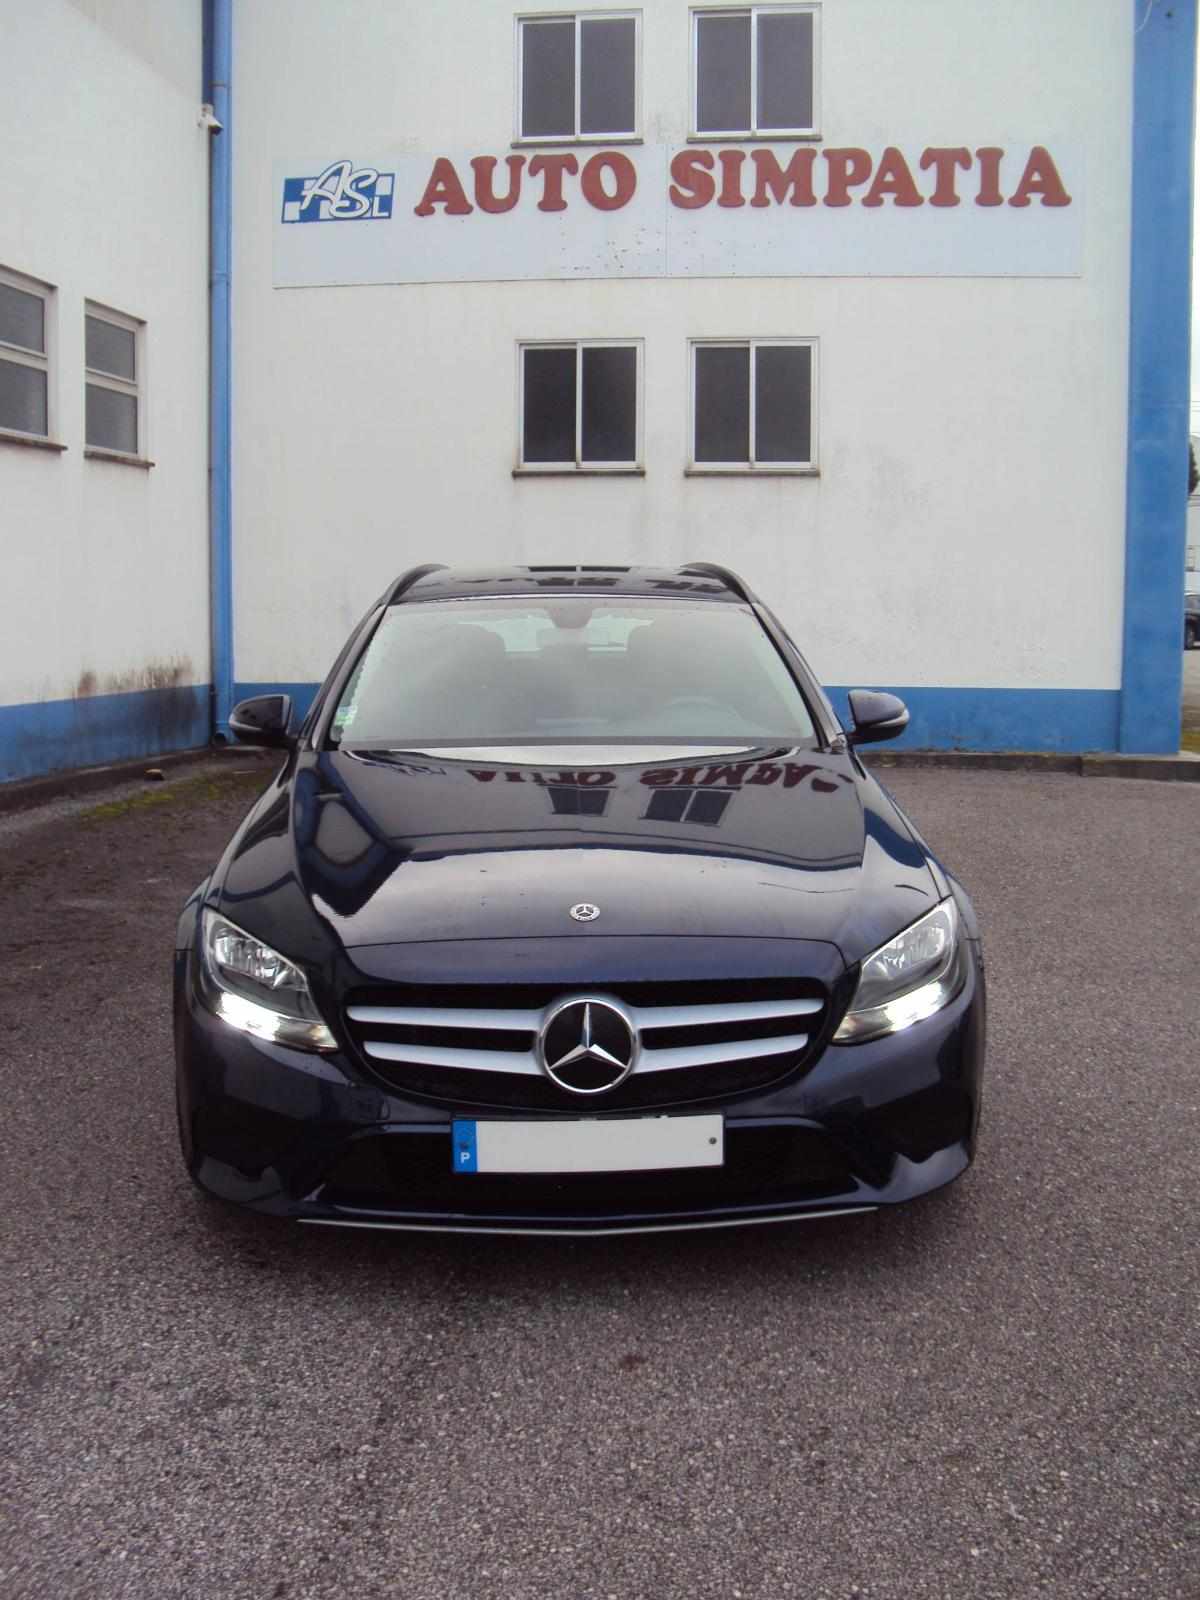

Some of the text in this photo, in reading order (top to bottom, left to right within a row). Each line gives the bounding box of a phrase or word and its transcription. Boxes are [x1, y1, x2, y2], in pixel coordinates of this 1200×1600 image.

[414, 146, 1072, 217] AUTO SIMPATIA
[460, 1152, 471, 1164] P
